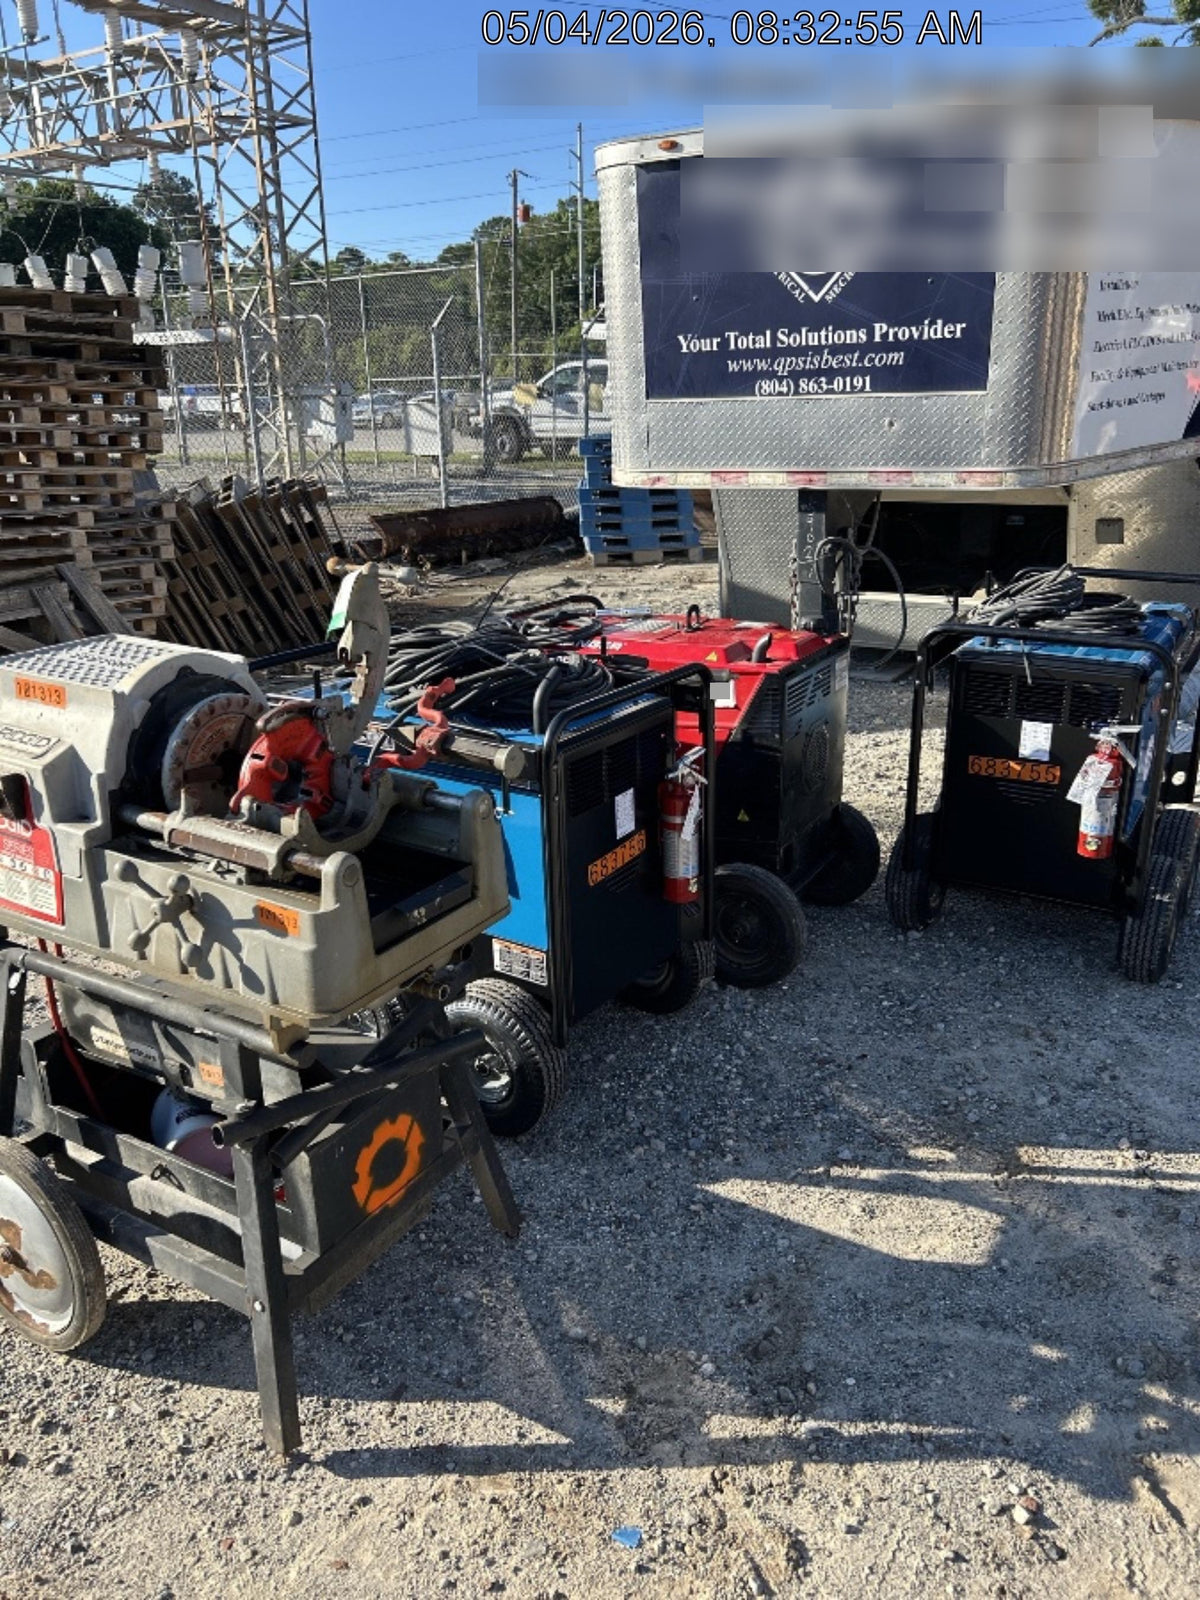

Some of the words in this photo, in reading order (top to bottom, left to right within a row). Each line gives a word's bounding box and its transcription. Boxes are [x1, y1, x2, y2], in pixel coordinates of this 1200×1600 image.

[677, 333, 721, 353] Your
[725, 330, 771, 350] Total
[777, 326, 867, 347] Solutions
[874, 319, 966, 343] Provider
[726, 350, 905, 375] www.qpsisbest.com
[755, 378, 794, 396] (804)
[799, 375, 872, 395] 863-0191
[970, 756, 1057, 783] 683755
